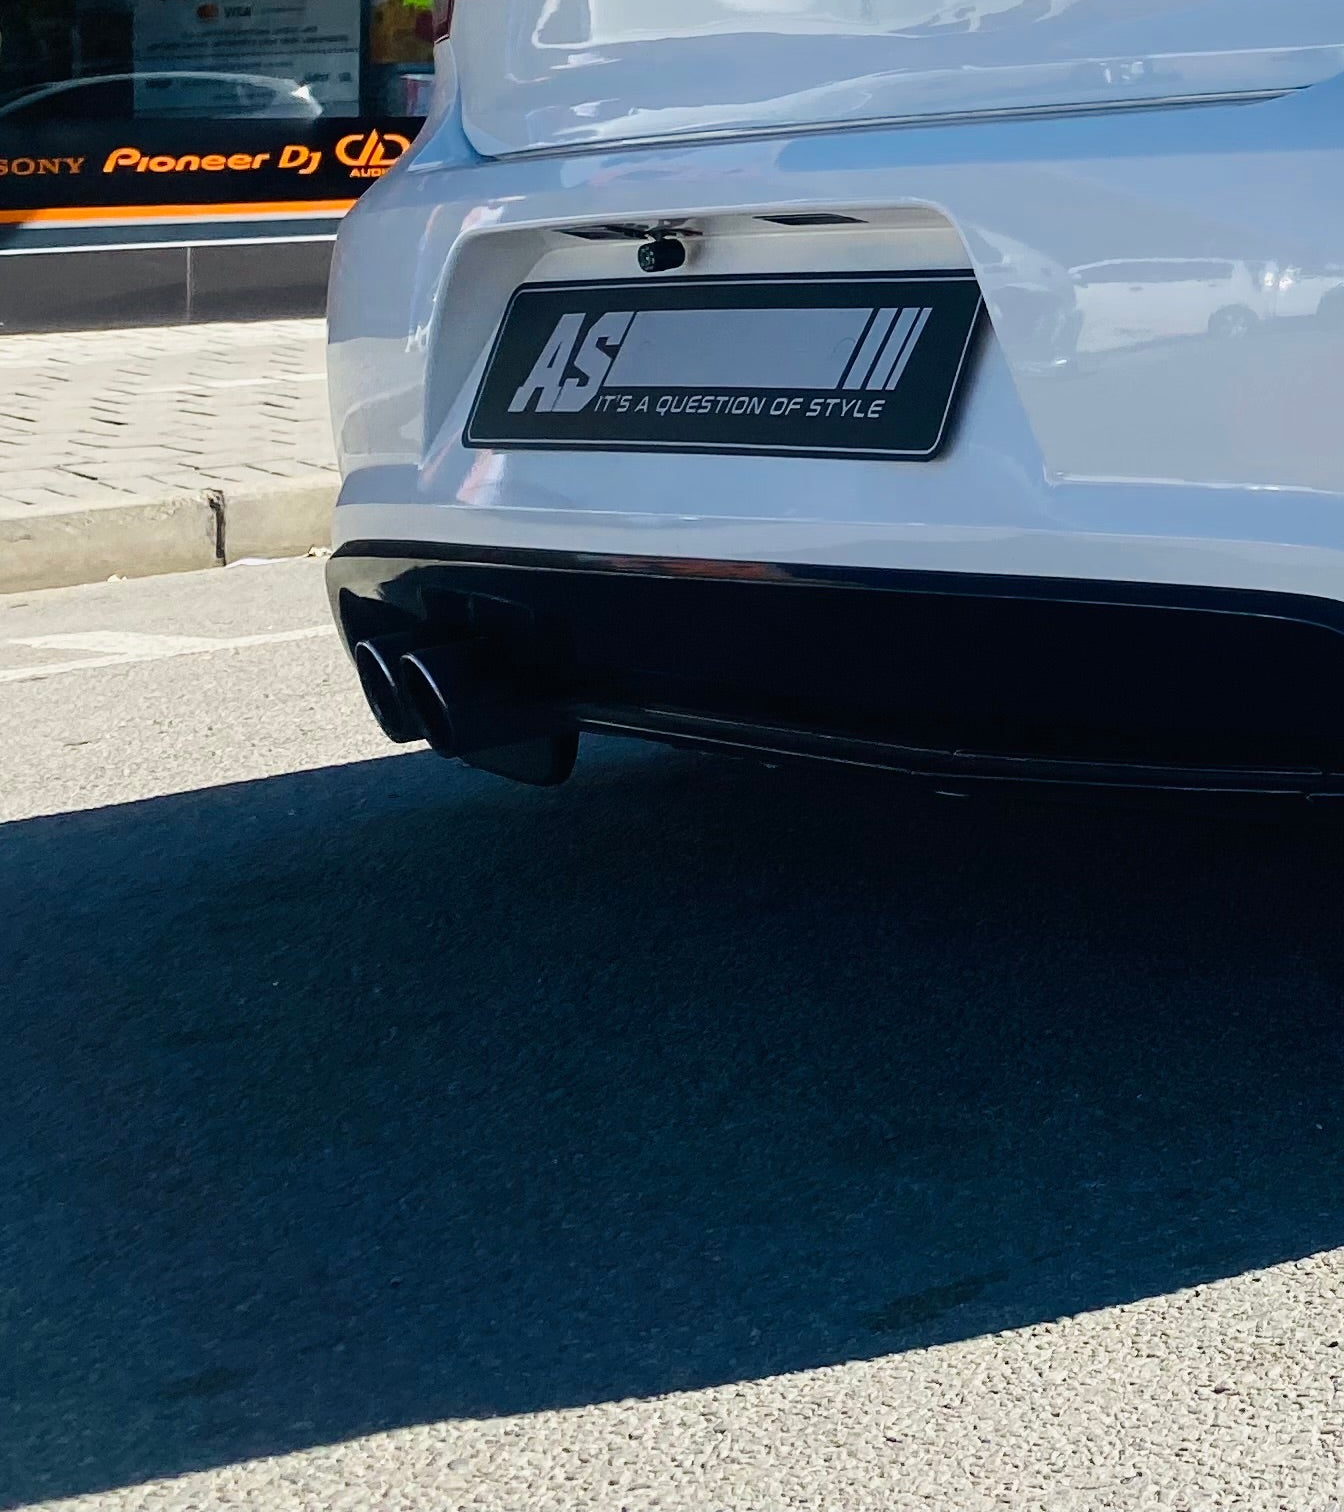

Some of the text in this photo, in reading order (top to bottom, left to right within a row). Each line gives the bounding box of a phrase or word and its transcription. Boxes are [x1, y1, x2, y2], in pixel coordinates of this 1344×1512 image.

[0, 157, 85, 176] SONY
[102, 147, 270, 173] Pioneer
[349, 168, 391, 179] AUDI
[507, 311, 637, 413] AS
[594, 394, 887, 418] IT'S A QUESTION OF STYLE
